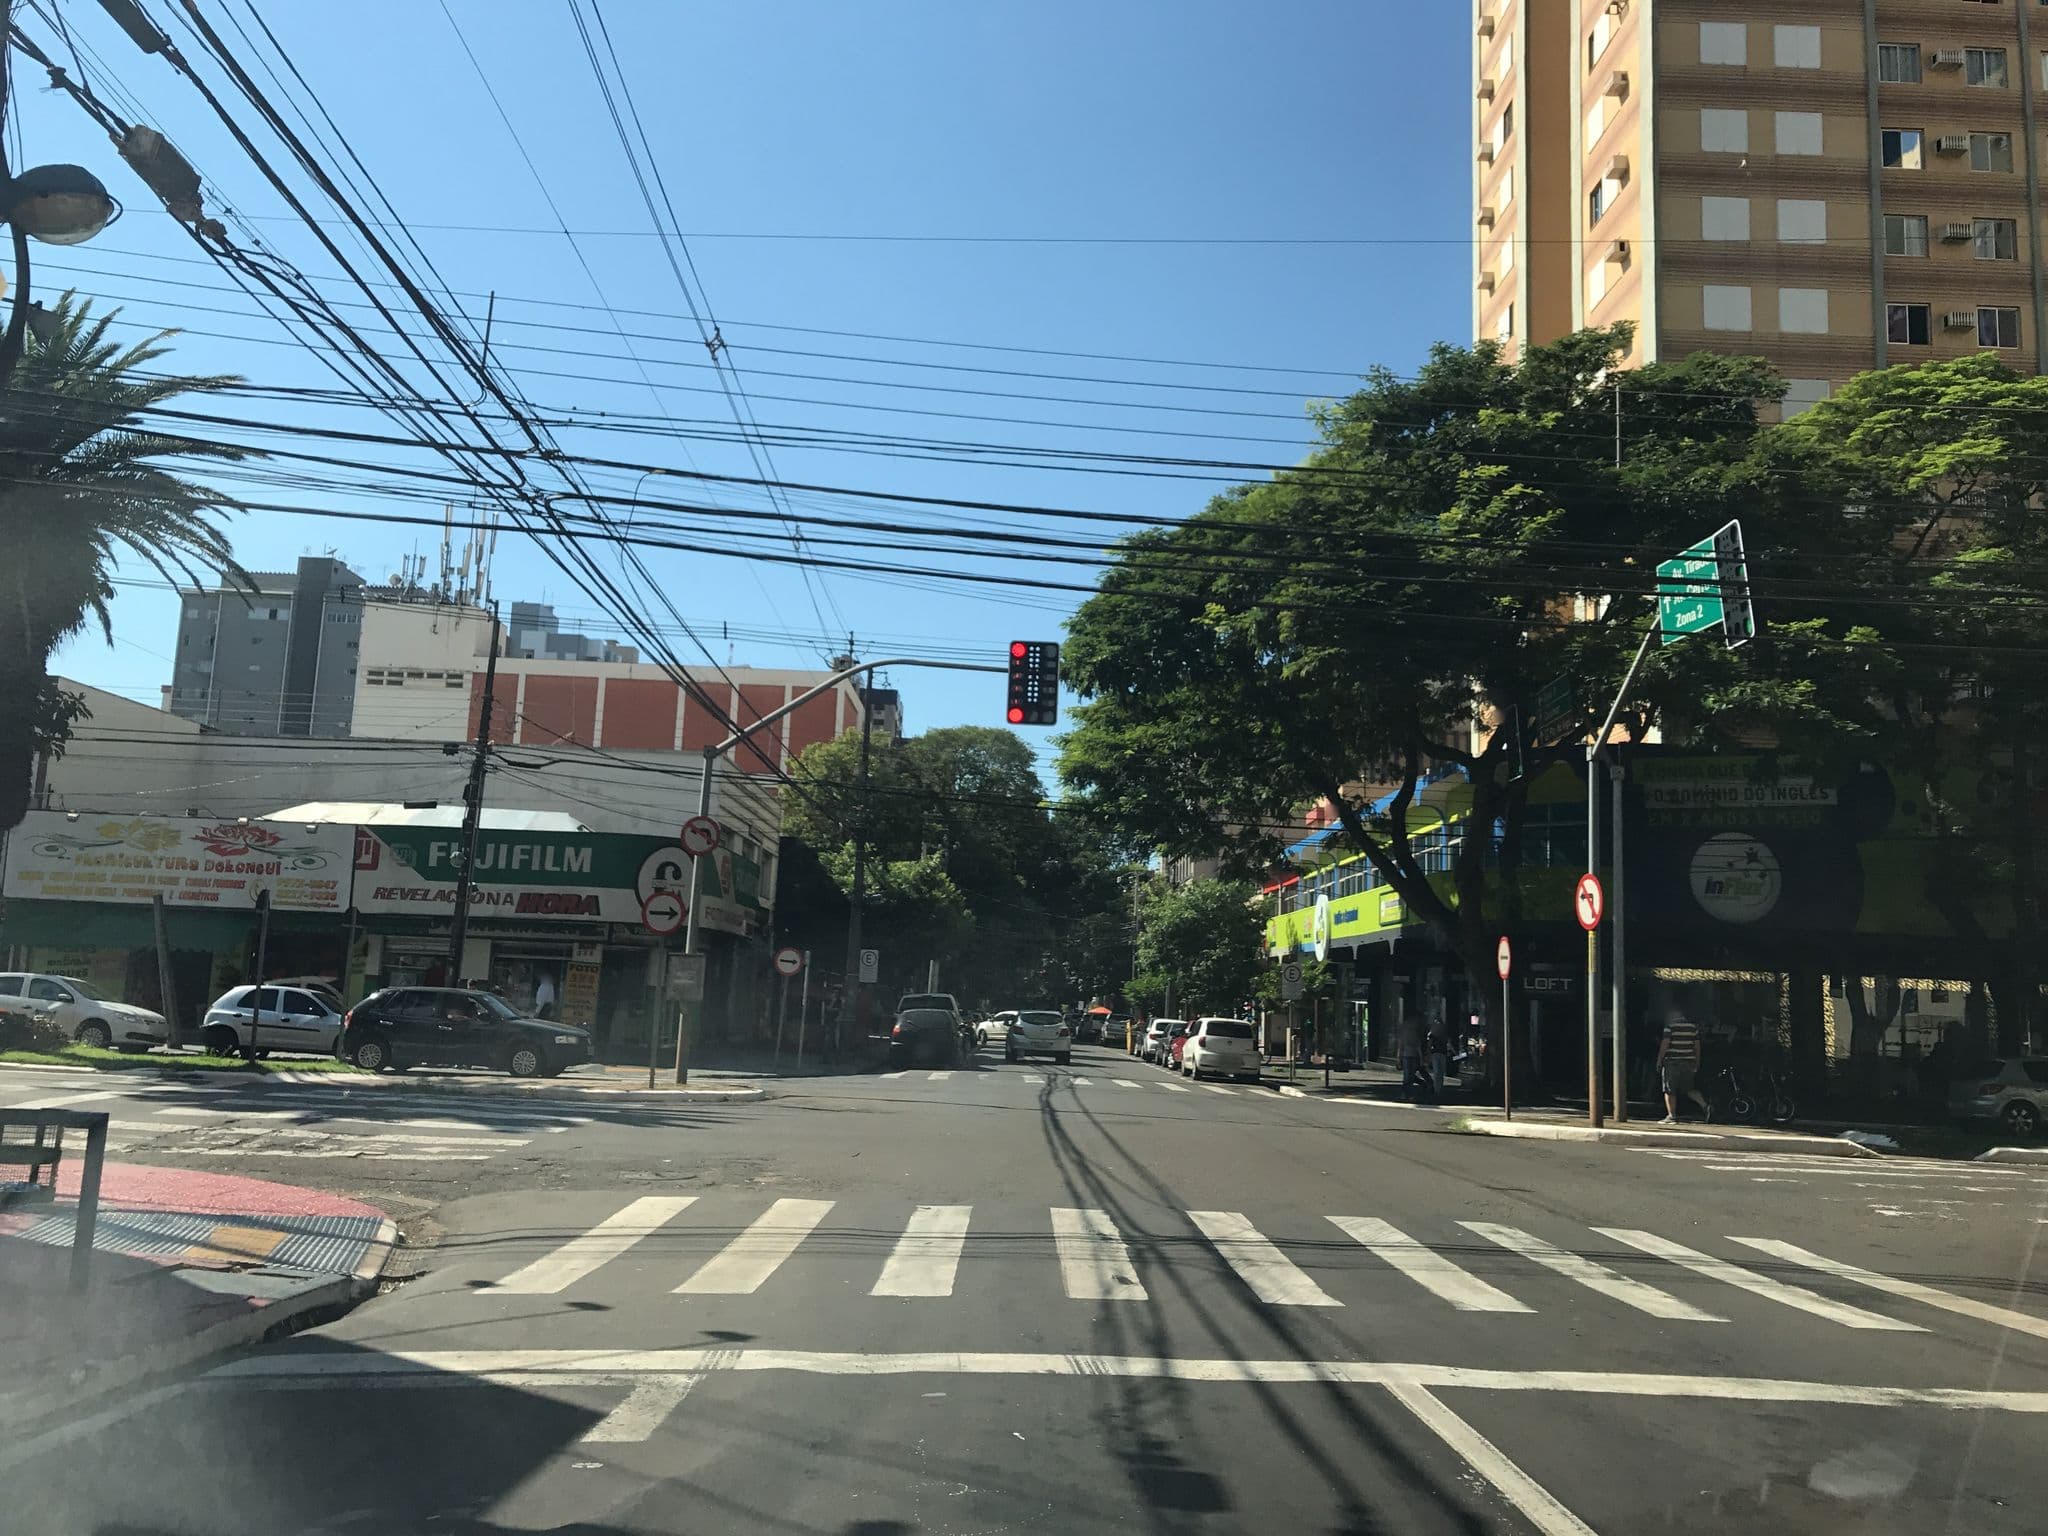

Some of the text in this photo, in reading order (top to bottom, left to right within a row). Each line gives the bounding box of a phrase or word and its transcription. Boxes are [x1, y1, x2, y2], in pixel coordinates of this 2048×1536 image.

[1675, 604, 1704, 628] Zona 2
[1744, 787, 1765, 801] DO
[1523, 977, 1573, 990] LOFT
